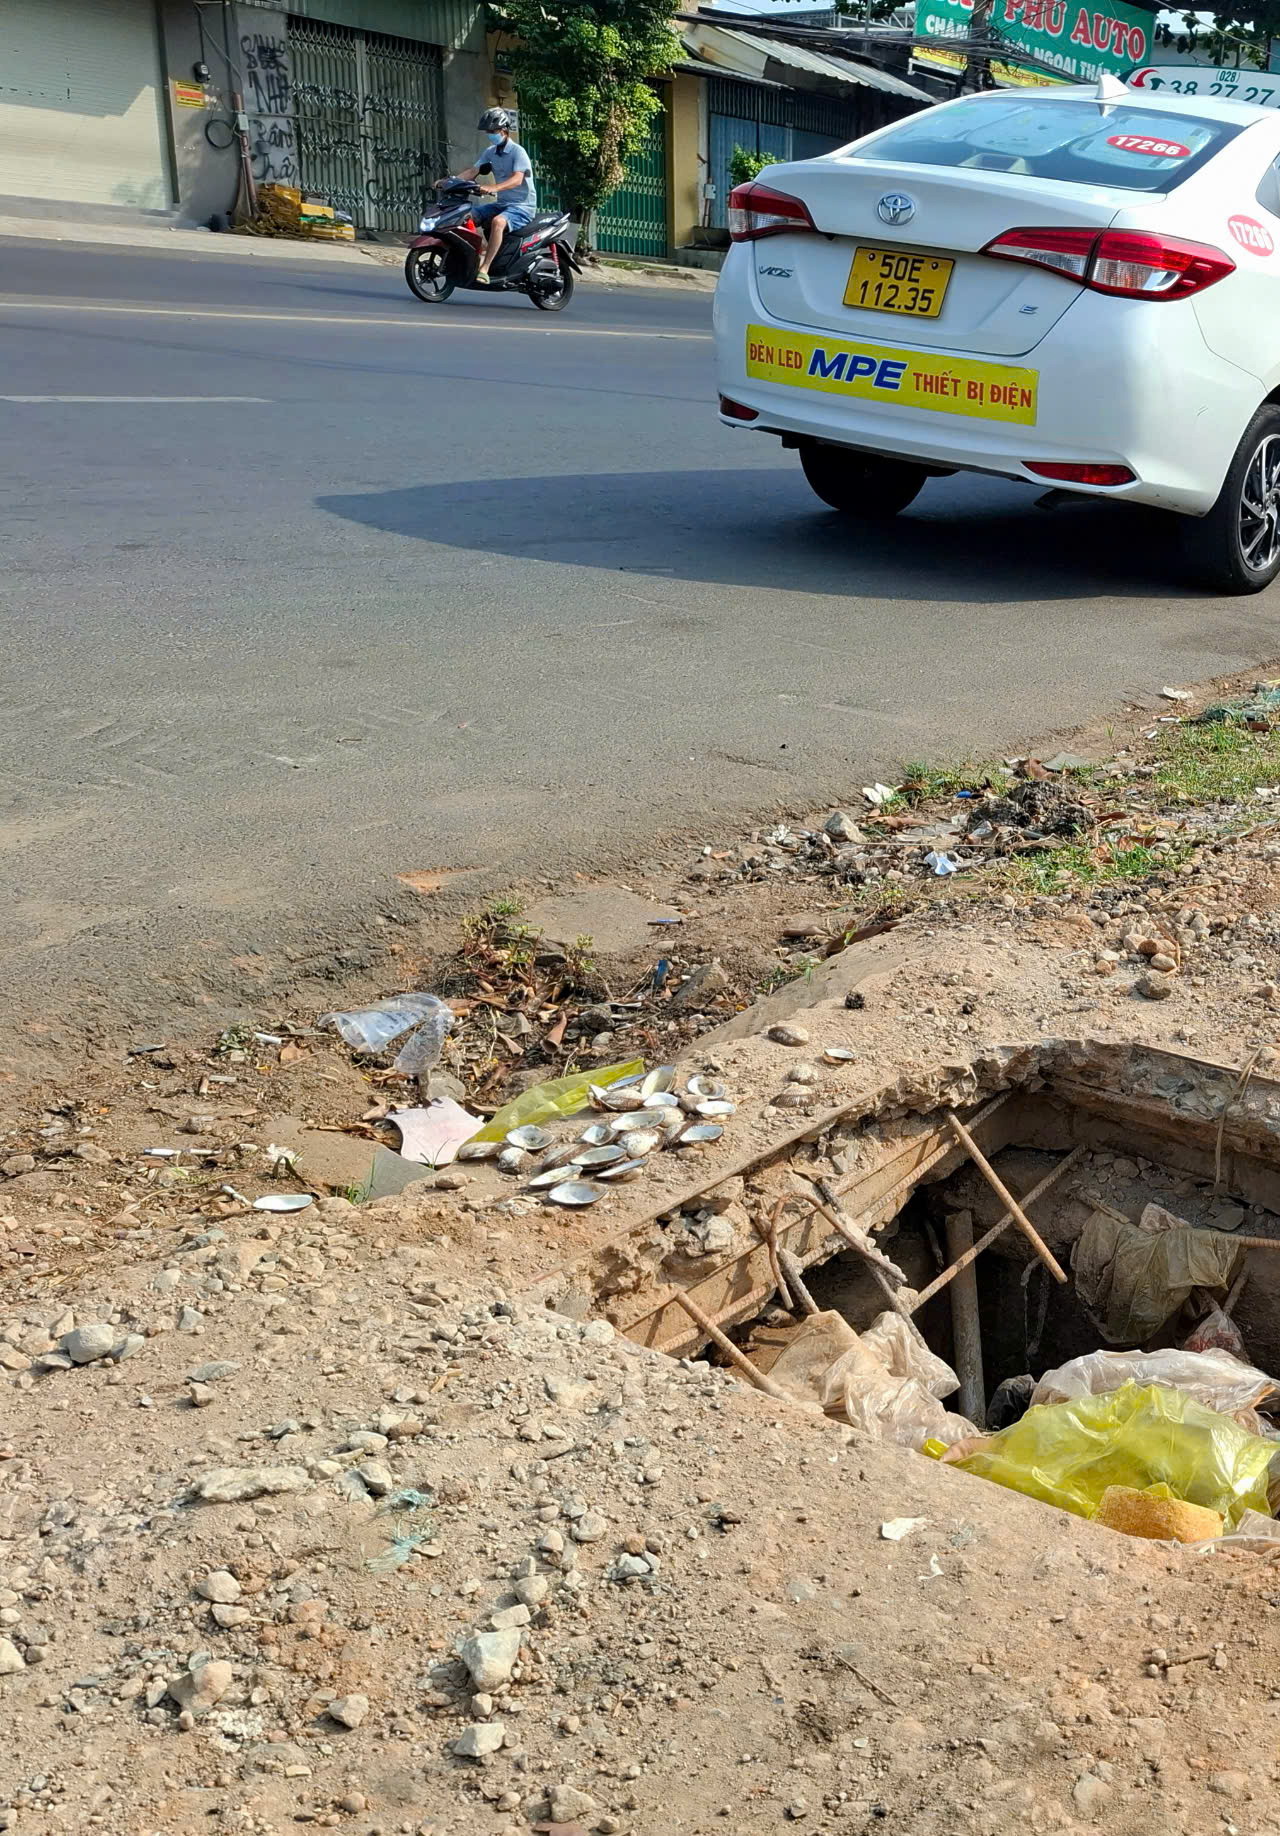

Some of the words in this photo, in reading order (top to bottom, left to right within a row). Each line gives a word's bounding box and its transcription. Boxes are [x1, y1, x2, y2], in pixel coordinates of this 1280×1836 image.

[1070, 8, 1146, 62] AUTO
[1215, 70, 1240, 83] (028)
[1170, 80, 1198, 96] 38
[1209, 83, 1239, 98] 27
[1244, 87, 1275, 110] 27
[1115, 135, 1181, 156] 17266
[878, 254, 926, 284] 50E
[859, 280, 935, 313] 112.35
[749, 339, 775, 364] ĐÈN
[778, 349, 803, 370] LED
[808, 348, 908, 390] MPE
[912, 366, 962, 397] THIẾT
[966, 380, 984, 406] BỊ
[989, 381, 1033, 410] ĐIỆN
